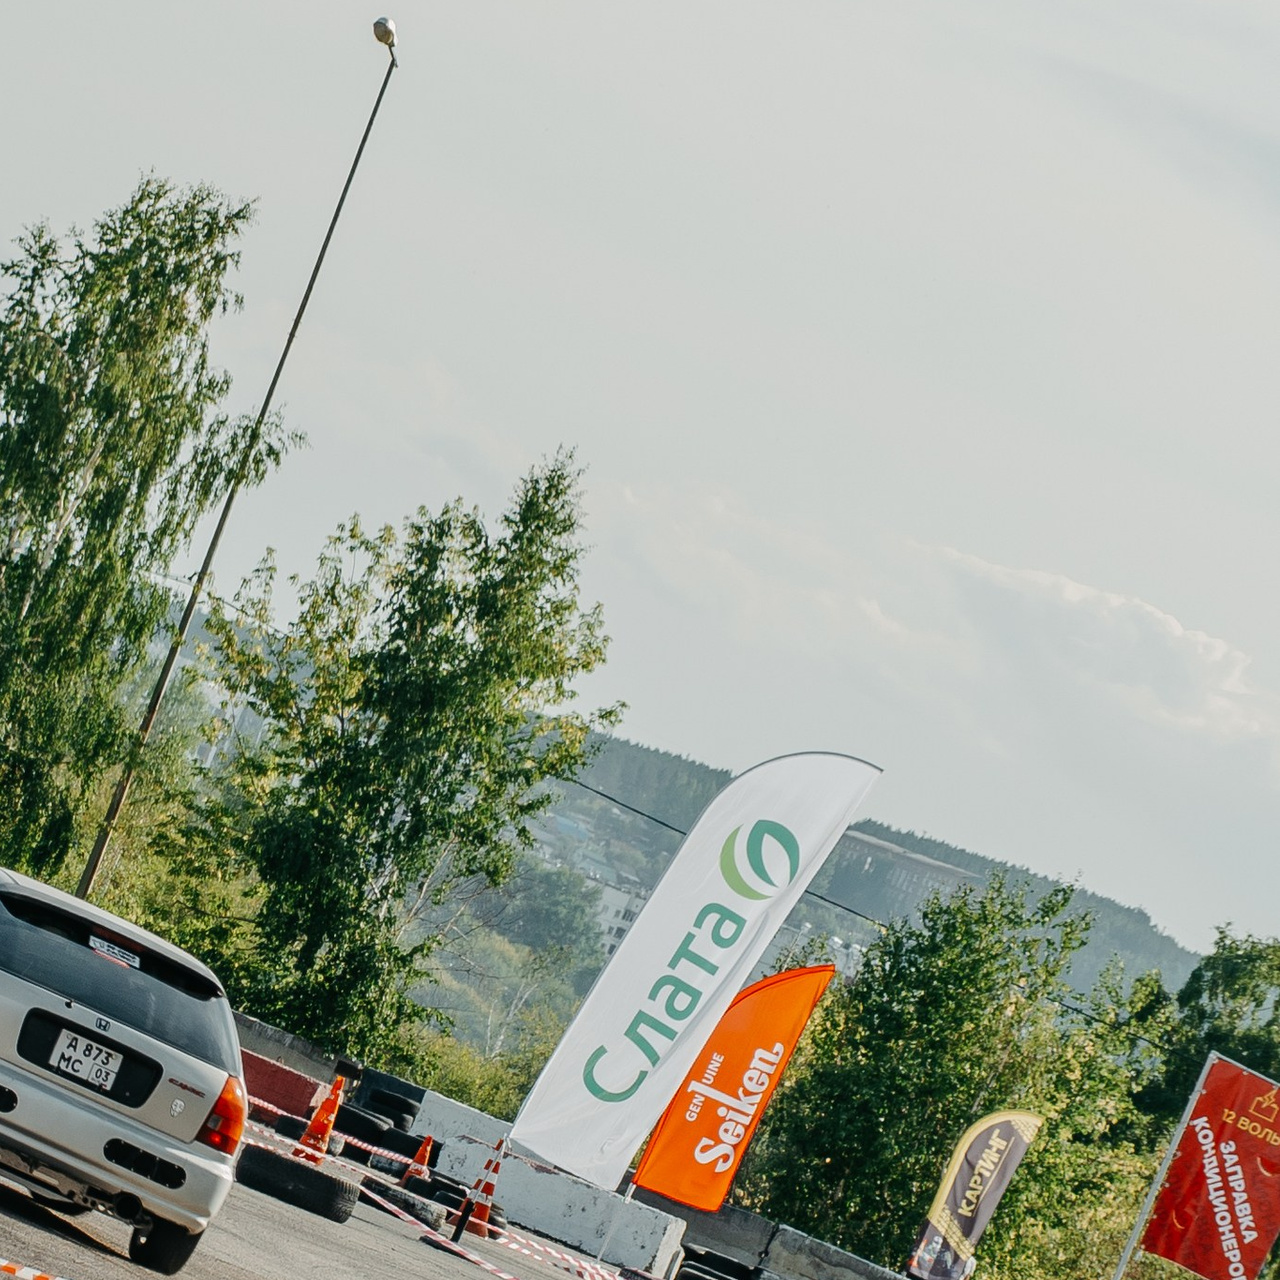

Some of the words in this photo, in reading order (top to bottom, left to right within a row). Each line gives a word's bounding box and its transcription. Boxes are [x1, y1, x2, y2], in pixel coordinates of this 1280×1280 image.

[83, 1043, 113, 1065] 873
[95, 1068, 111, 1082] 03
[687, 1042, 784, 1173] Seiken
[1222, 1108, 1237, 1124] 12
[1237, 1116, 1280, 1146] ВОЛЬ
[957, 1128, 1008, 1218] КАРТИНГ
[1220, 1140, 1259, 1245] ЗАПРАВКА
